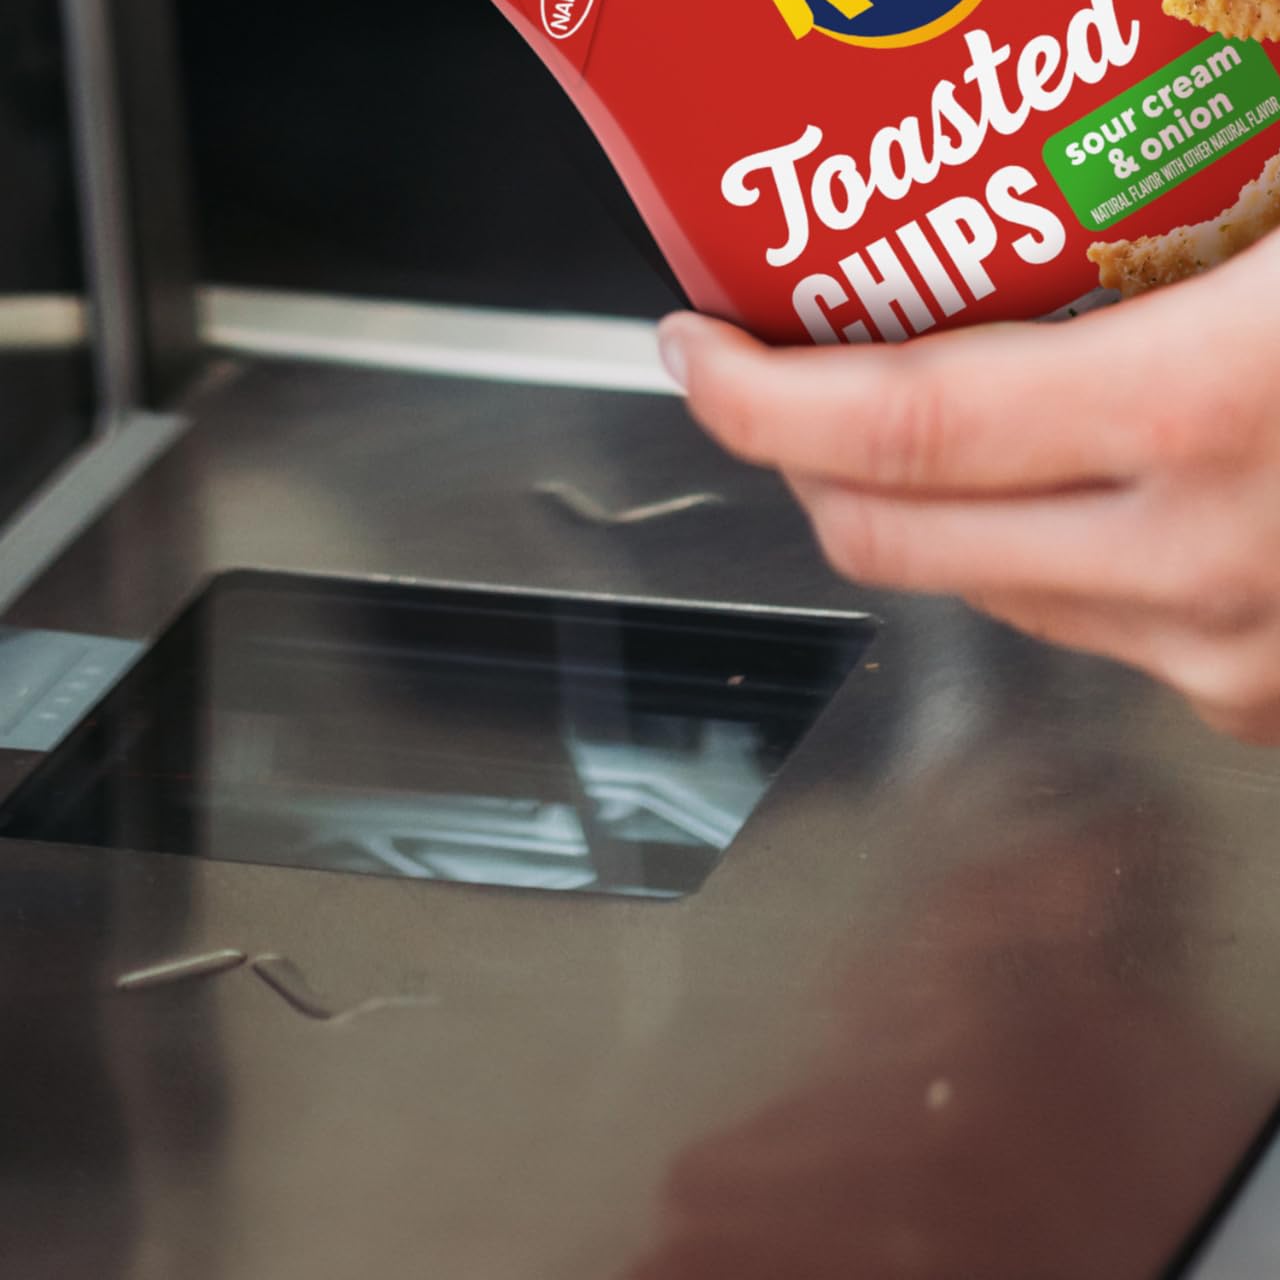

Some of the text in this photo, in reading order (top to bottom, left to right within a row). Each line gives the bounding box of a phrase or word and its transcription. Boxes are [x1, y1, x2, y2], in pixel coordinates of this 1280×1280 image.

[1065, 45, 1242, 166] sour cream
[1090, 96, 1280, 224] NATURAL FLAVOR WITH OTHER NATURAL FLAVOR
[1108, 92, 1234, 179] & onion
[792, 165, 1066, 344] CHIPS
